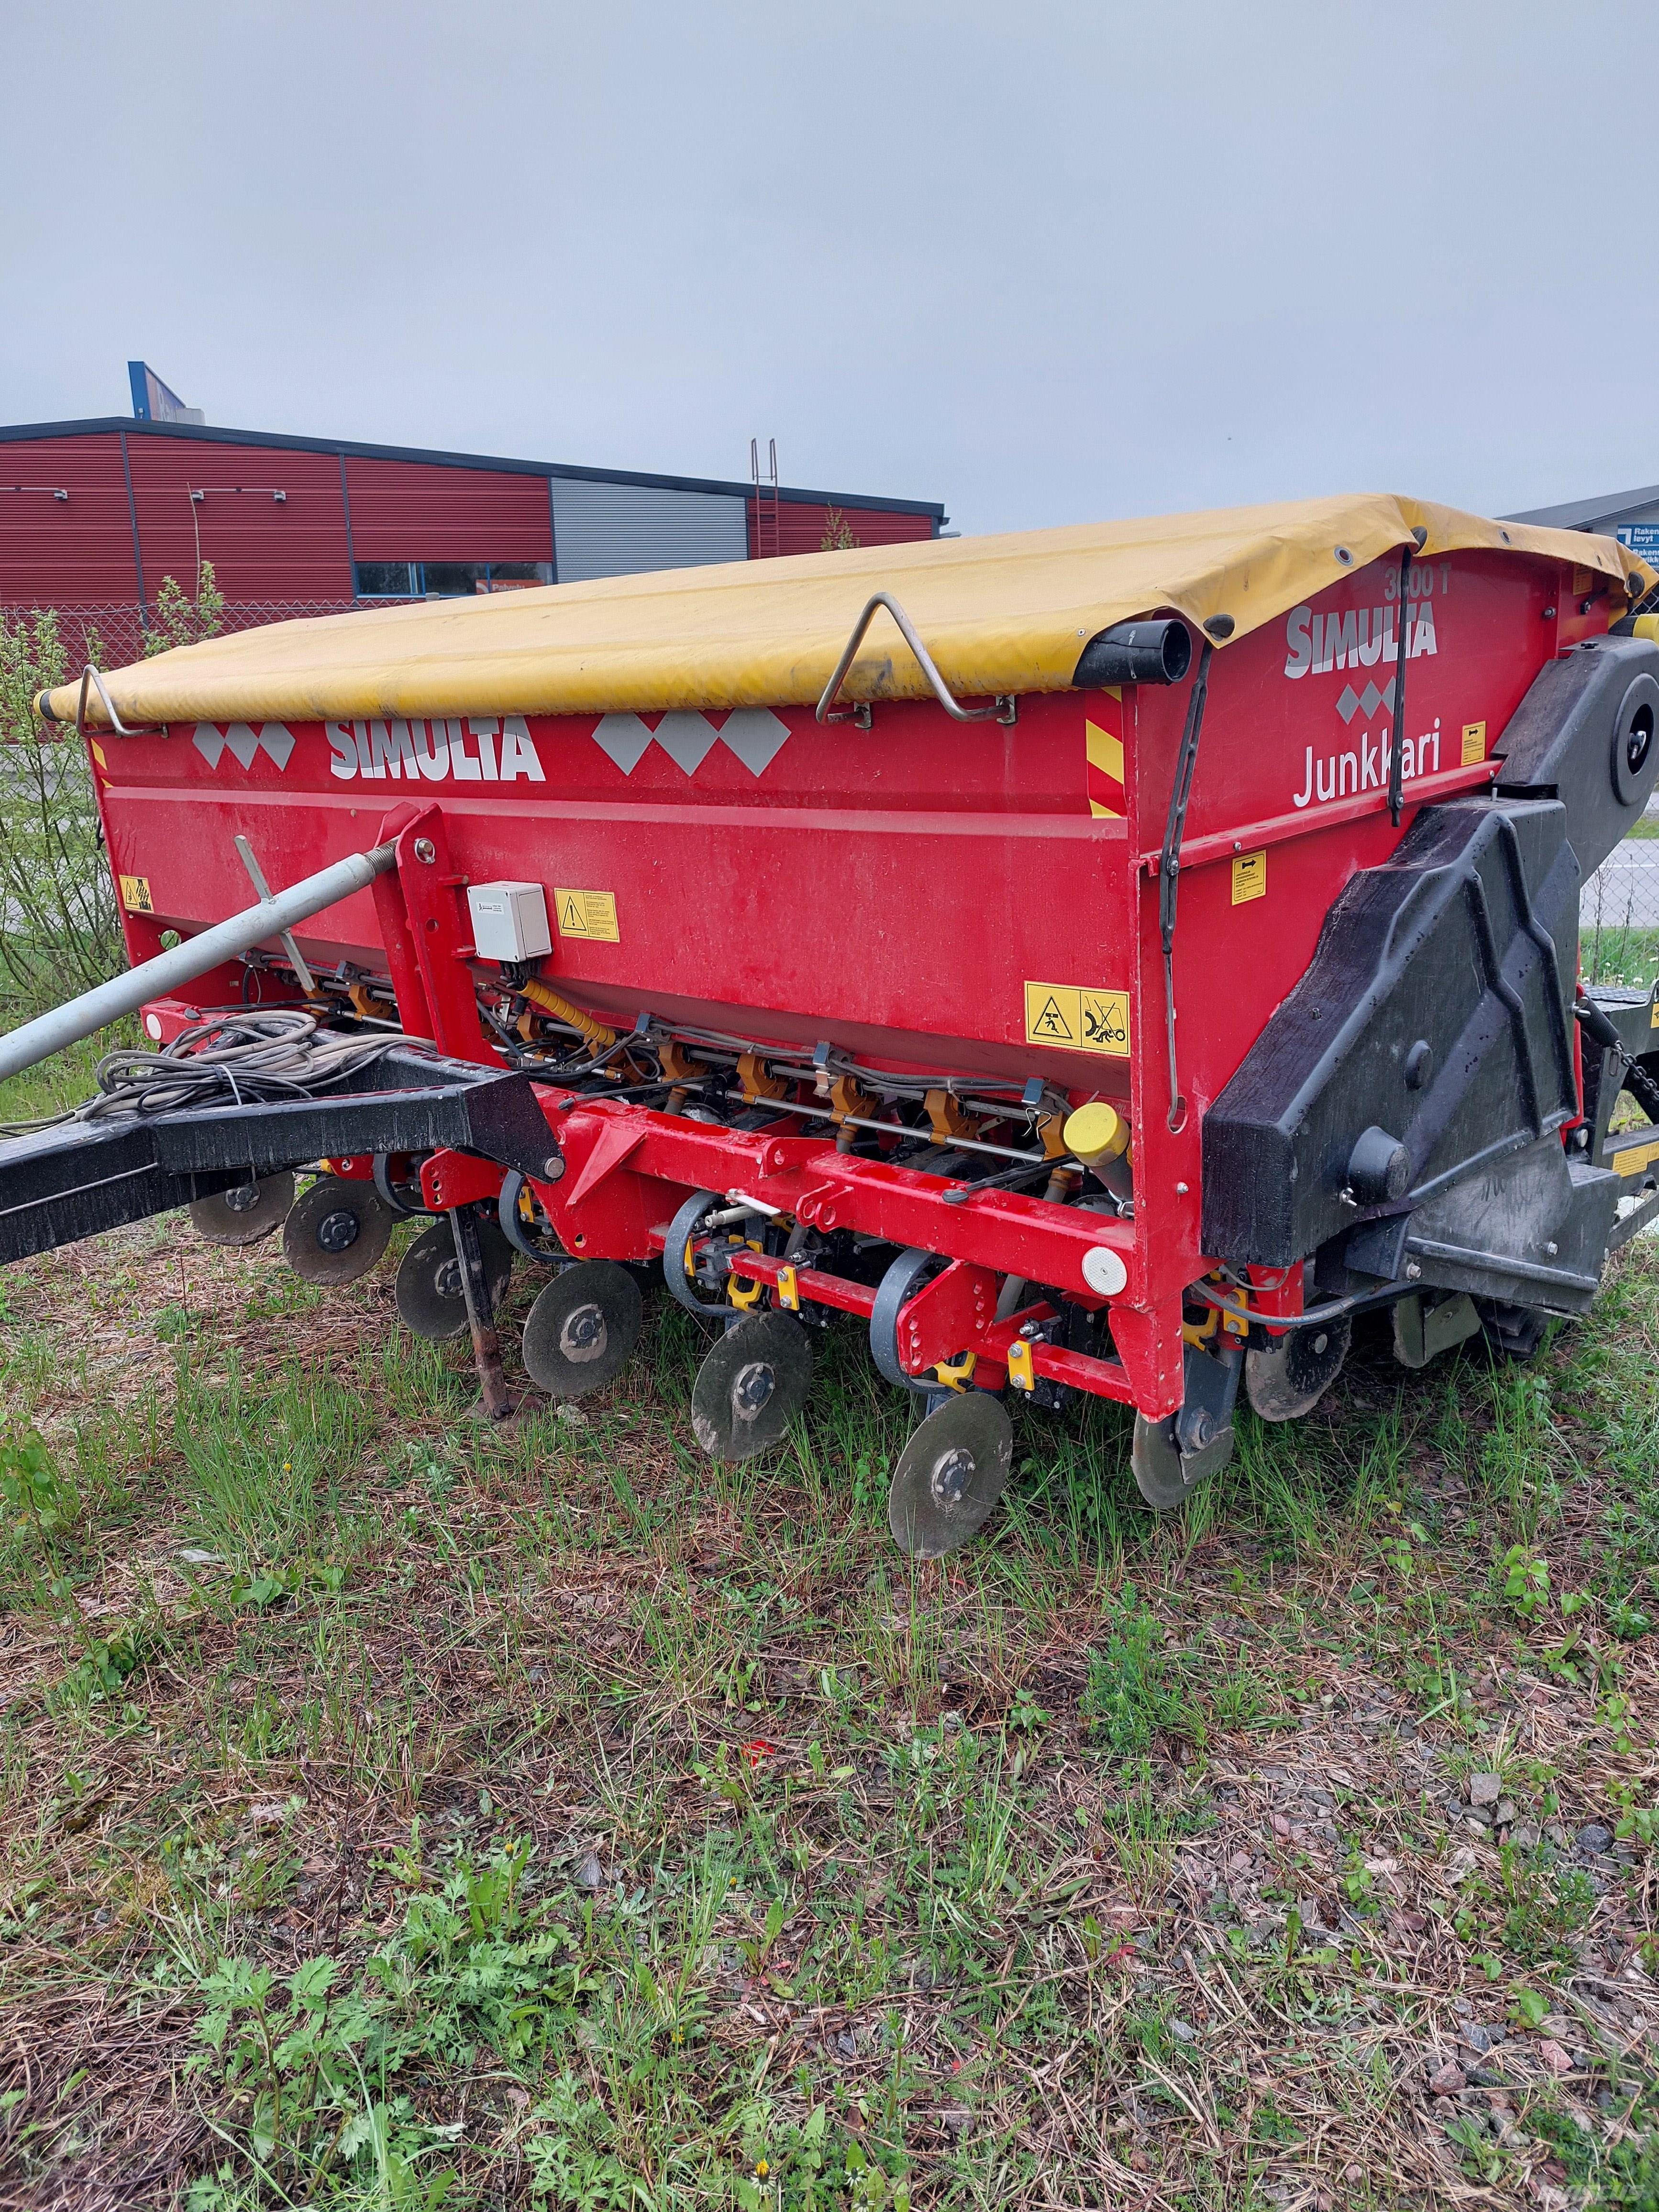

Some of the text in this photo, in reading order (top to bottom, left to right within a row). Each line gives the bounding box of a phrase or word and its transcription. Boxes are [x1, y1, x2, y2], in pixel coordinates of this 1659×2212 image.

[1439, 562, 1452, 595] T
[1284, 601, 1438, 679] SIMULTA
[325, 715, 546, 781] SIMULTA
[1293, 717, 1440, 807] Junkkari
